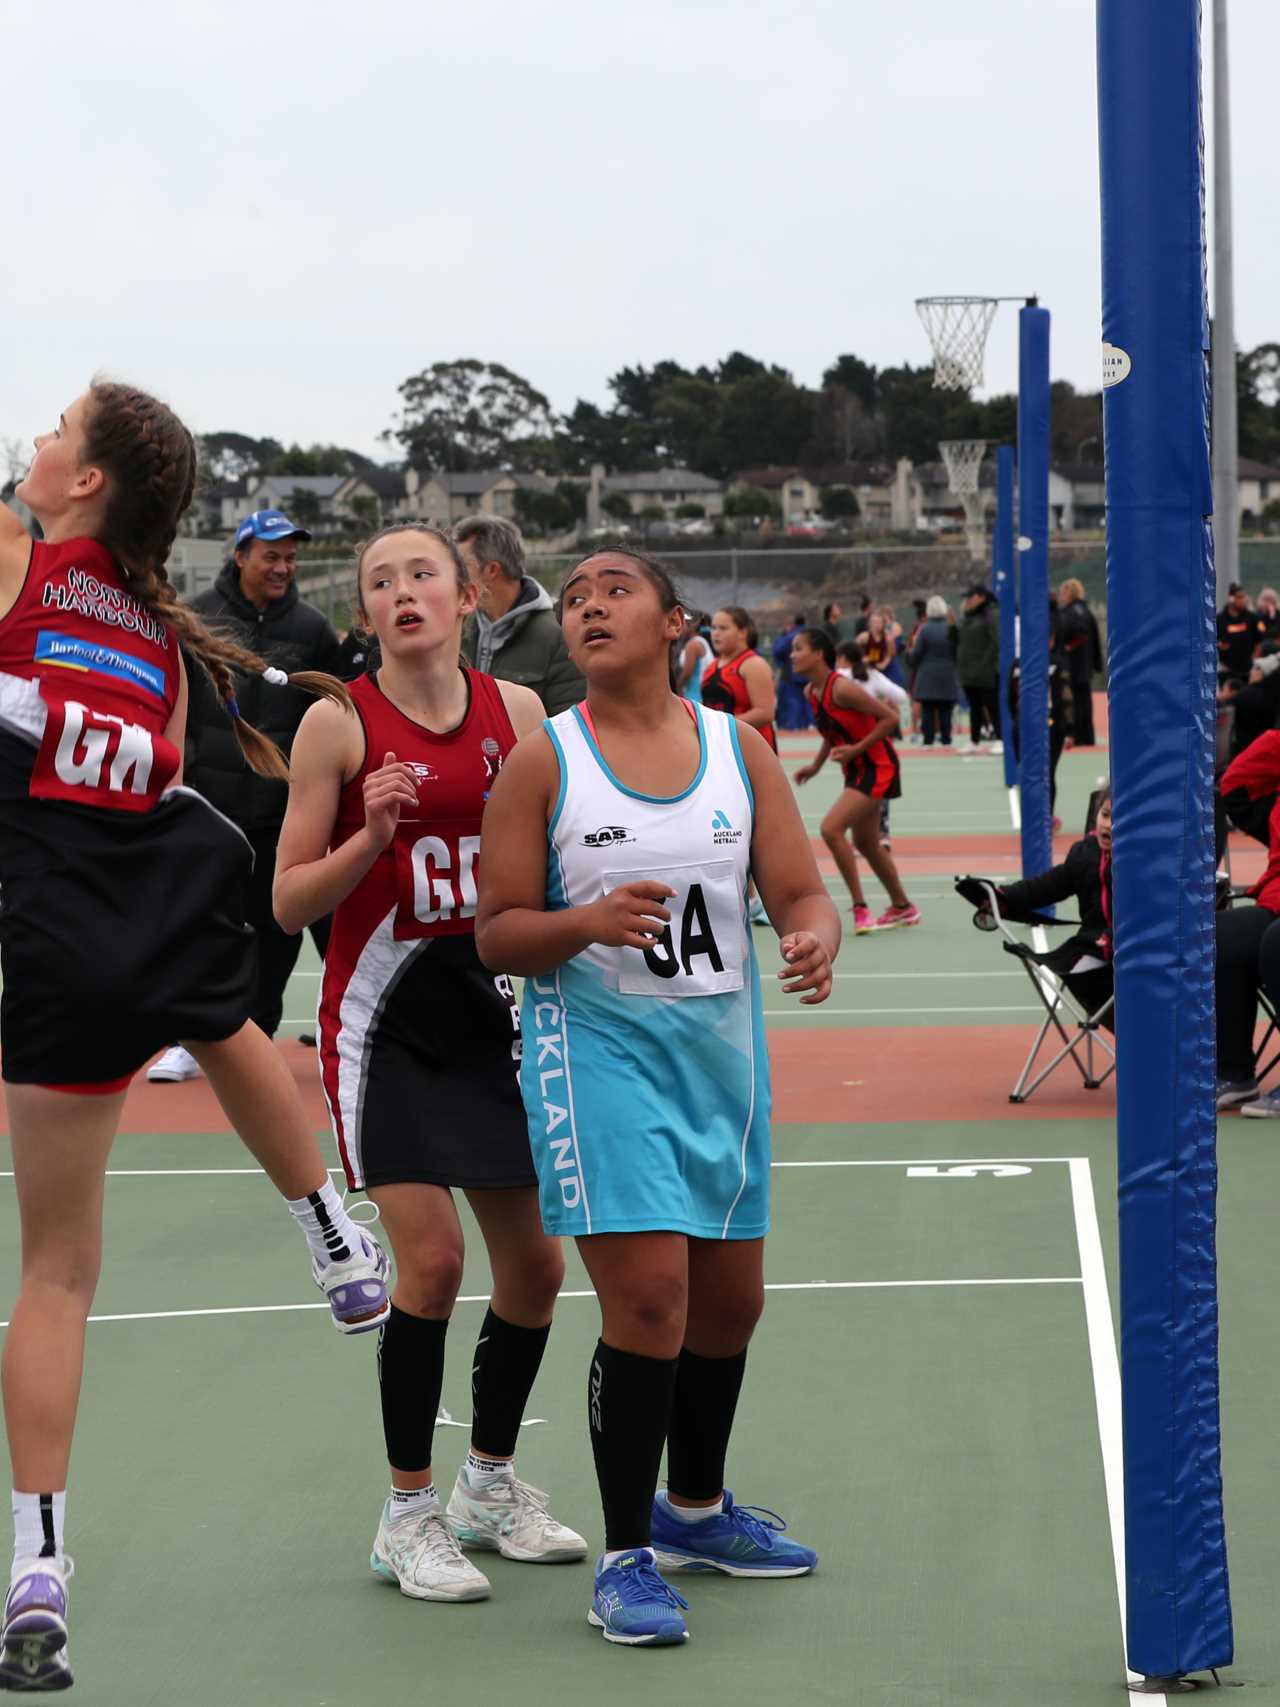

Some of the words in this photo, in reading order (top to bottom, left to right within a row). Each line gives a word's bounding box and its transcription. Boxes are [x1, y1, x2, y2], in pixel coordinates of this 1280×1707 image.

[42, 581, 168, 650] HARBOUR
[584, 829, 627, 844] SAS
[533, 975, 581, 1209] UCKLAND
